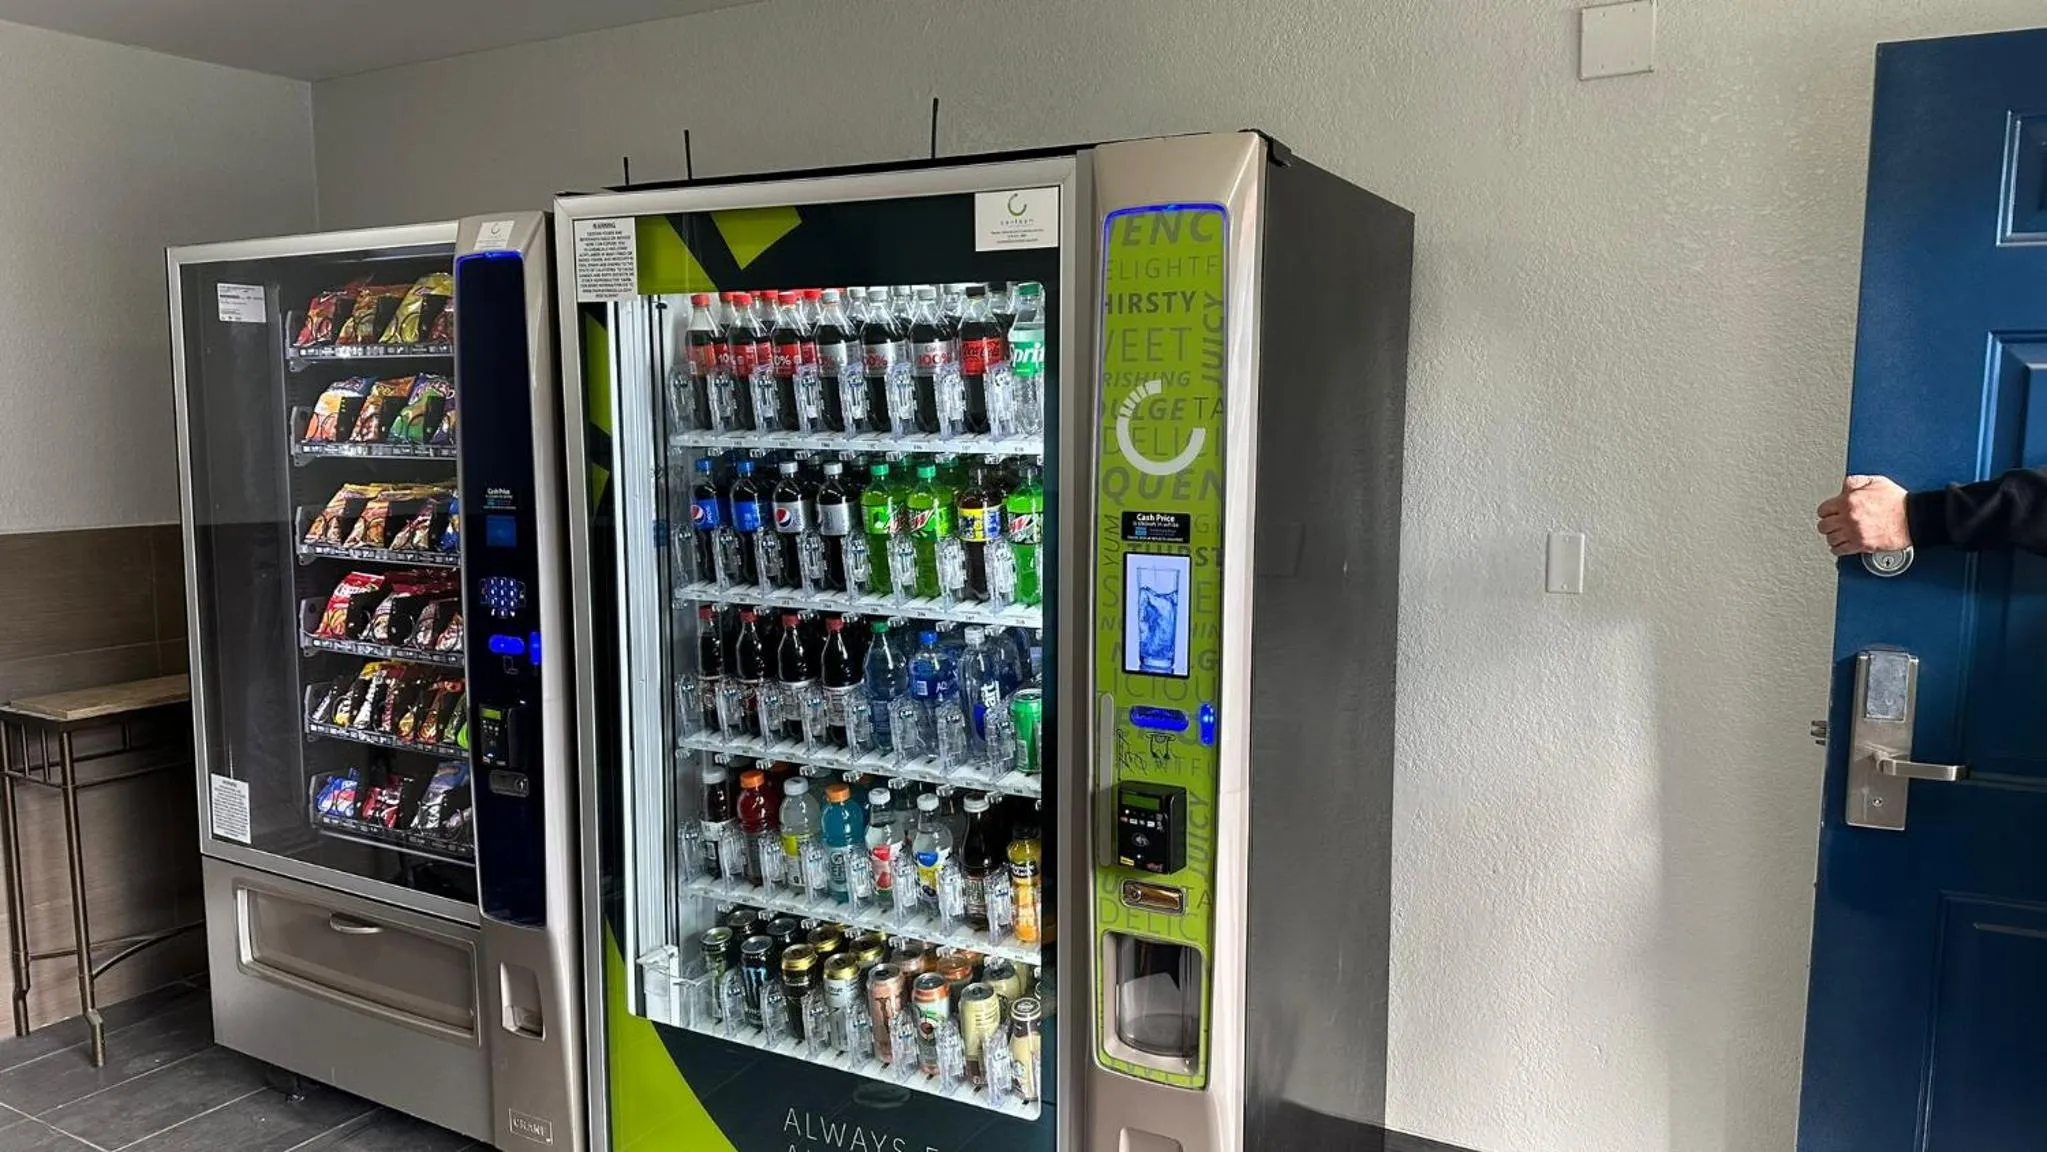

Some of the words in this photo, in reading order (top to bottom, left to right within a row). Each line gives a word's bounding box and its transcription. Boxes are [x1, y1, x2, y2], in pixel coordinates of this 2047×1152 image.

[1109, 211, 1216, 247] ENC
[1136, 512, 1155, 521] Cash
[1155, 513, 1175, 523] Price
